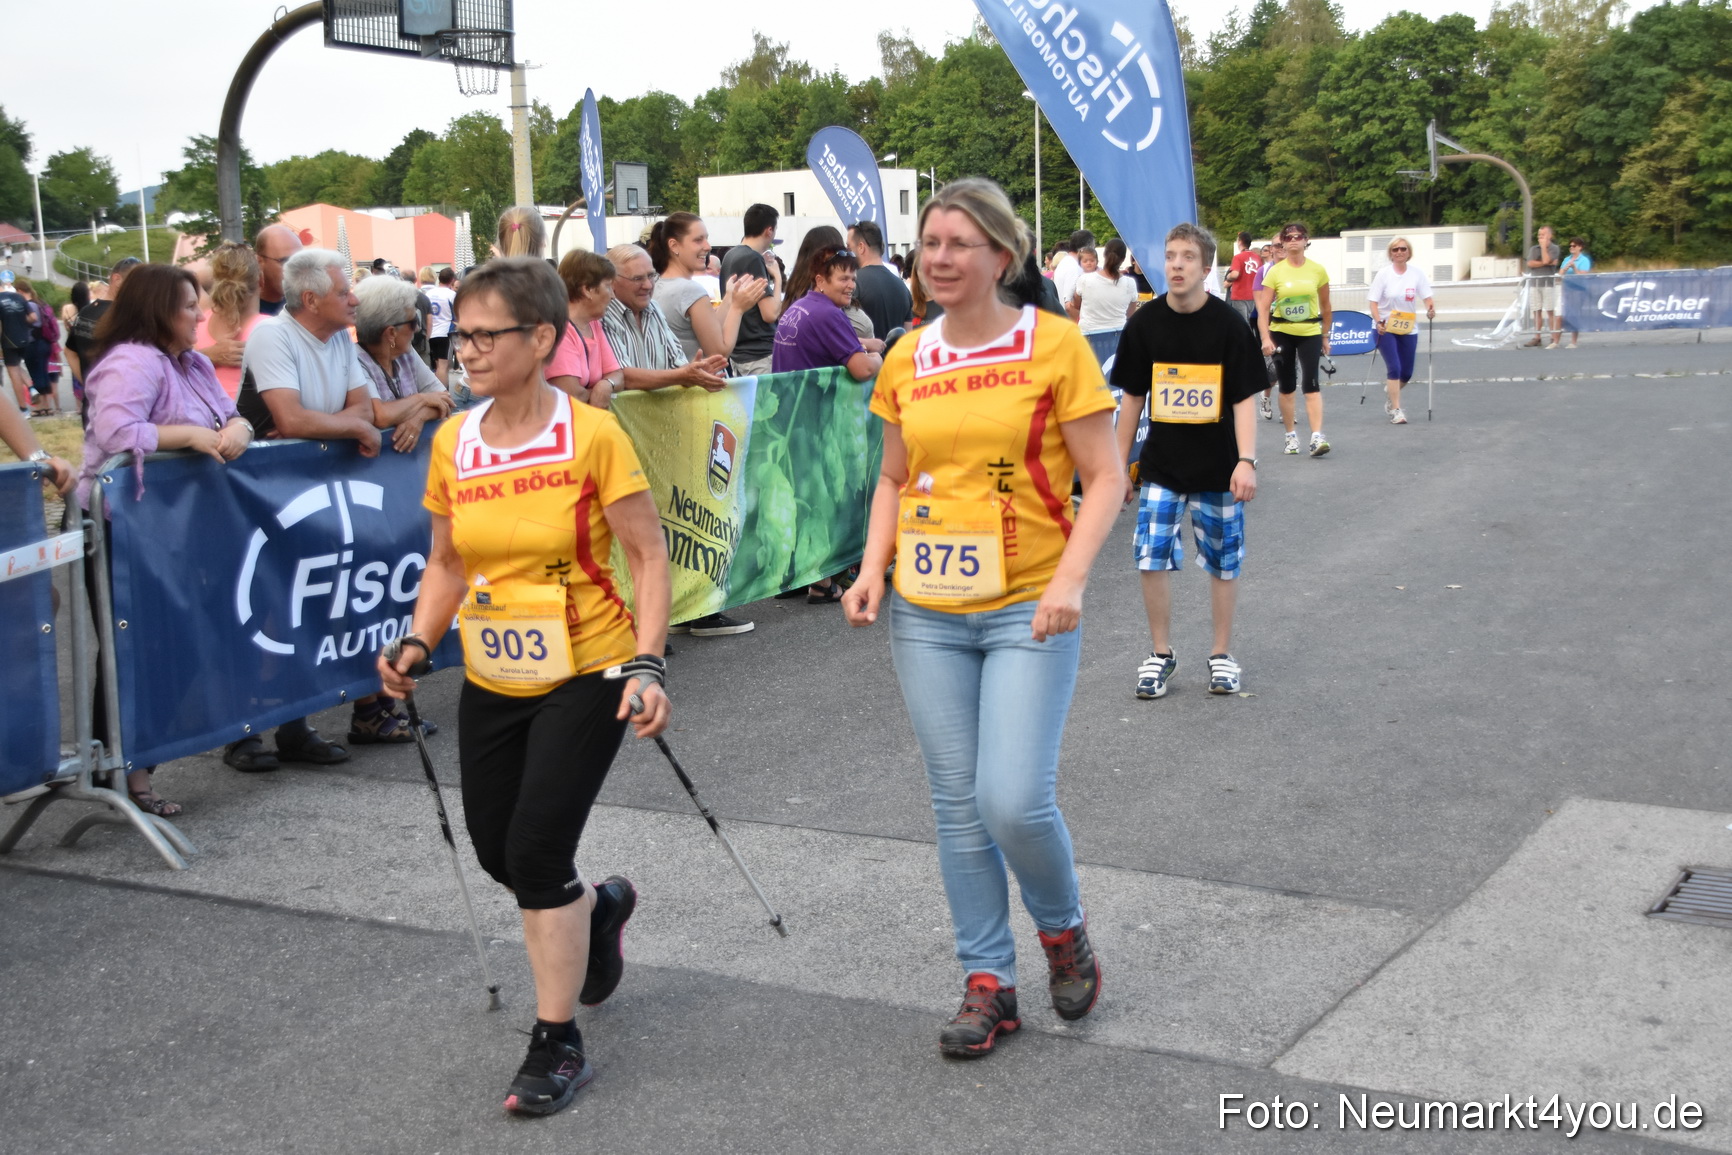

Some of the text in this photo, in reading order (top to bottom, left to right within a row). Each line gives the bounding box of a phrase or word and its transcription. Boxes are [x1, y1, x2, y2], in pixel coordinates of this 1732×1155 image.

[1285, 305, 1305, 317] 646
[1617, 294, 1709, 313] Fischer
[1392, 319, 1409, 330] 215
[1625, 312, 1701, 322] AUTOMOBILE
[1328, 329, 1371, 341] ischer
[910, 378, 958, 402] MAX
[966, 368, 1032, 392] BÖGL
[1160, 387, 1213, 408] 1266
[457, 482, 506, 506] MAX
[513, 469, 579, 496] BÖGL
[915, 542, 980, 577] 875
[291, 551, 427, 629] Fisc
[921, 582, 974, 592] Petra Denkinger
[481, 627, 548, 661] 903
